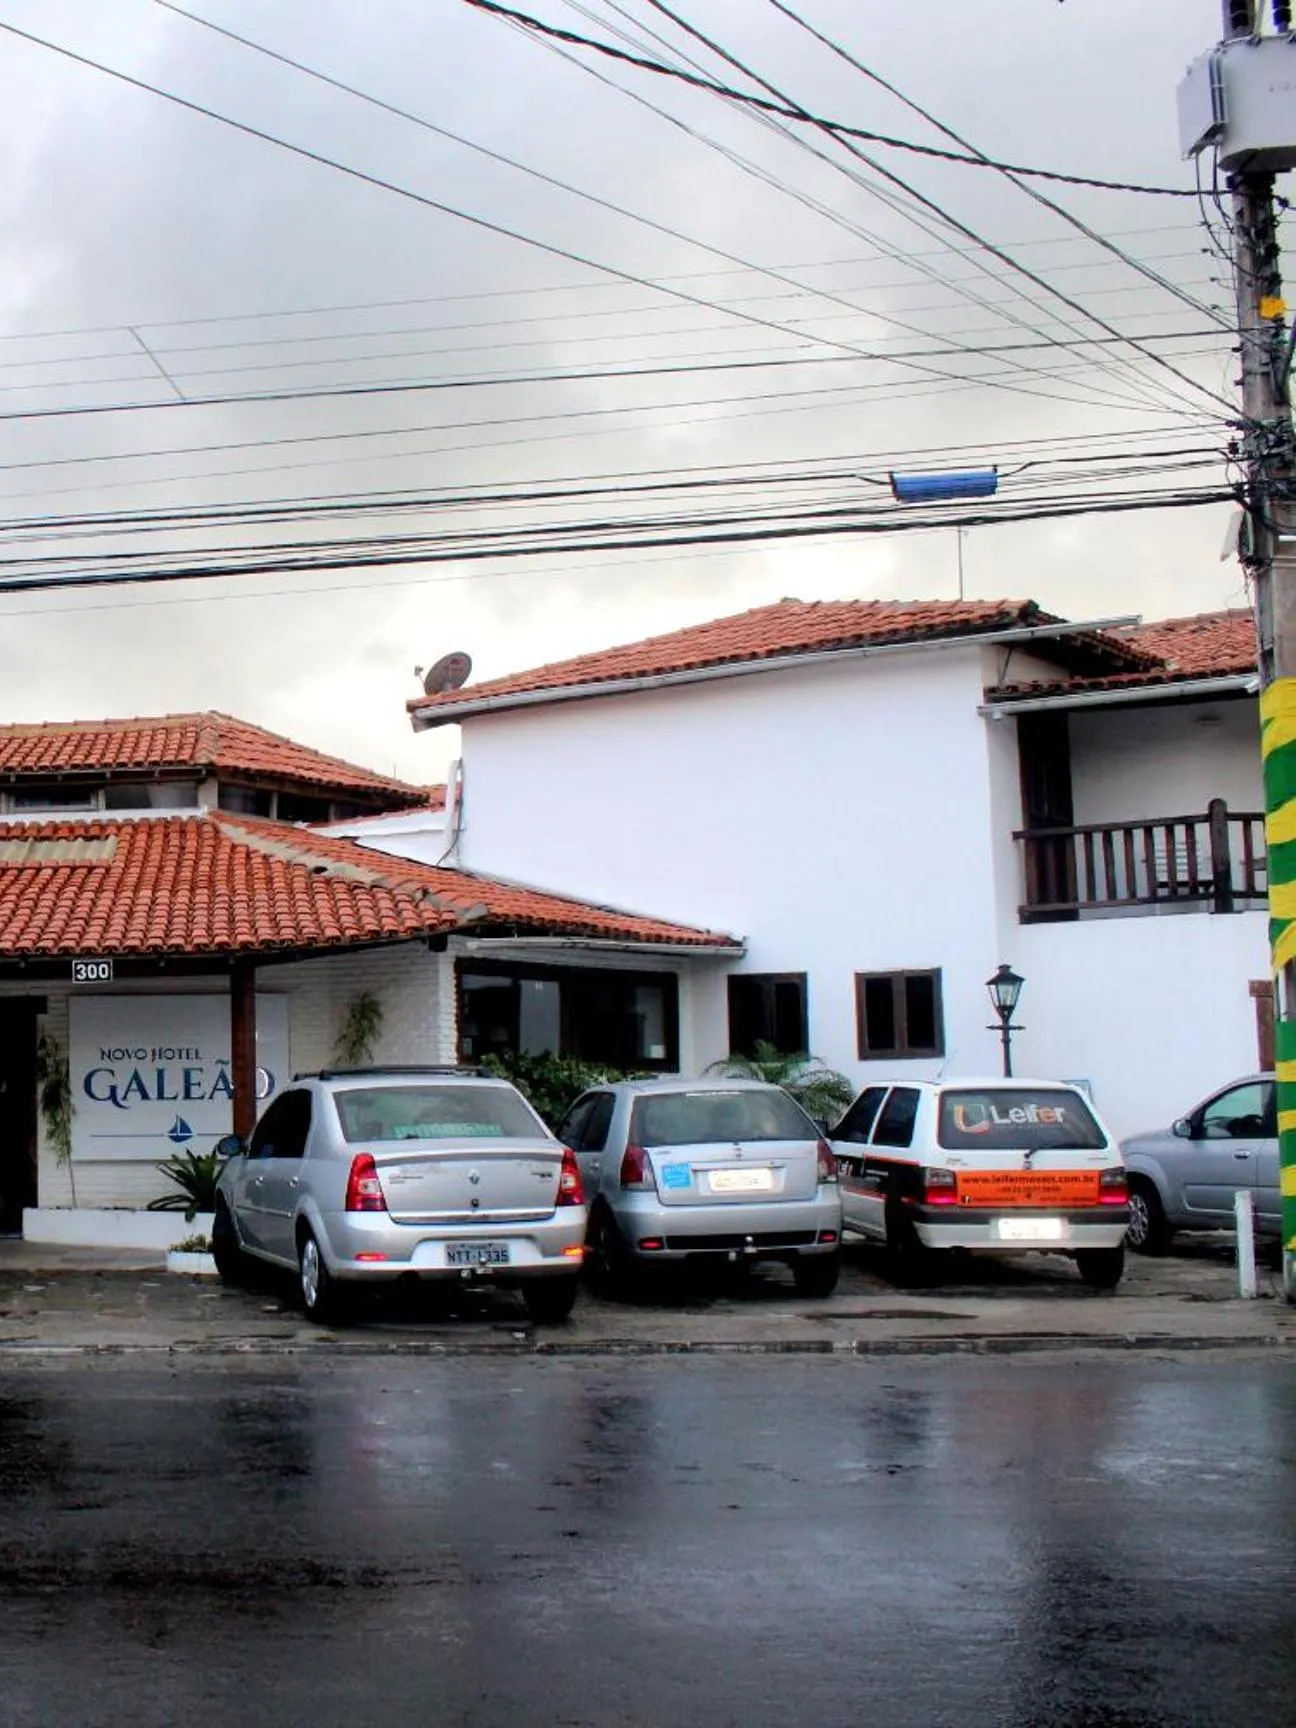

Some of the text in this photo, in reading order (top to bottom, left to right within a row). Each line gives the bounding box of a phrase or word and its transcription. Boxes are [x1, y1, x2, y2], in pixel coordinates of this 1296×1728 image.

[75, 963, 109, 980] 300
[100, 1047, 203, 1062] NOVO HOTEL
[990, 1104, 1066, 1124] Leifer
